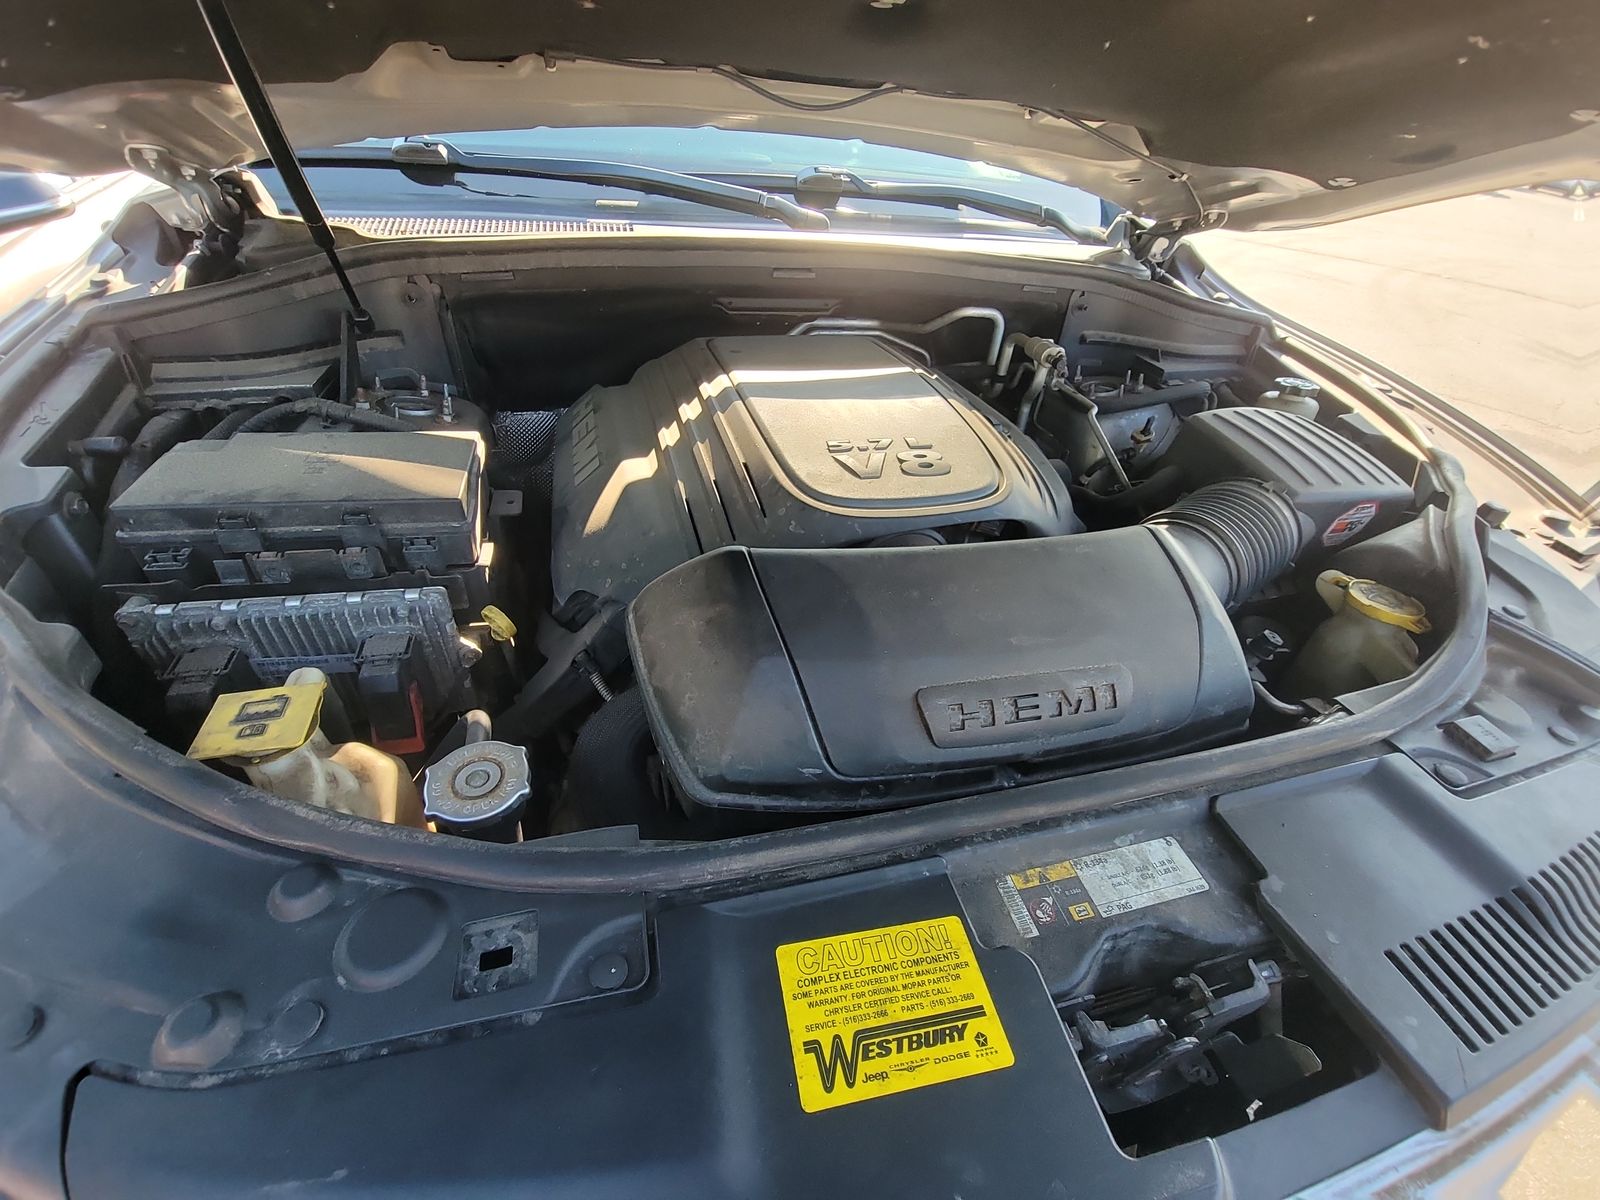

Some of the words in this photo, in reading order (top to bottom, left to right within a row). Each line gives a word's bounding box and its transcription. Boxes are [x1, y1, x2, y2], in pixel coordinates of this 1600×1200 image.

[826, 438, 893, 454] 5.7
[903, 436, 933, 449] L
[831, 449, 951, 480] V8
[947, 683, 1118, 732] HEMI
[1116, 901, 1133, 912] PAG
[796, 923, 953, 976] CAUTION!
[792, 990, 814, 1001] SOME
[814, 985, 838, 997] PARTS
[840, 982, 855, 992] ARE
[855, 975, 889, 988] COVERED
[889, 974, 899, 982] BY
[900, 971, 915, 981] THE
[915, 961, 970, 977] MANUFACTURER
[797, 972, 842, 989] COMPLEX
[842, 961, 899, 981] ELECTRONIC
[900, 950, 960, 970] COMPONENTS
[851, 991, 867, 1001] FOR
[867, 984, 901, 997] ORIGINAL
[901, 979, 926, 991] MOPAR
[928, 976, 951, 985] PARTS
[951, 972, 962, 981] OR
[824, 1001, 862, 1017] CHRYSLER
[863, 996, 900, 1010] CERTIFIED
[900, 989, 932, 1002] SERVICE
[931, 986, 953, 996] CALL:
[901, 1002, 925, 1014] PARTS
[929, 998, 947, 1010] (516)
[805, 1019, 837, 1033] SERVICE
[842, 1009, 889, 1027] (516)333-2666
[803, 1022, 969, 1094] WESTBURY
[888, 1056, 930, 1070] CHRYSLER
[933, 1050, 971, 1065] DODGE
[862, 1070, 889, 1084] Jeep
